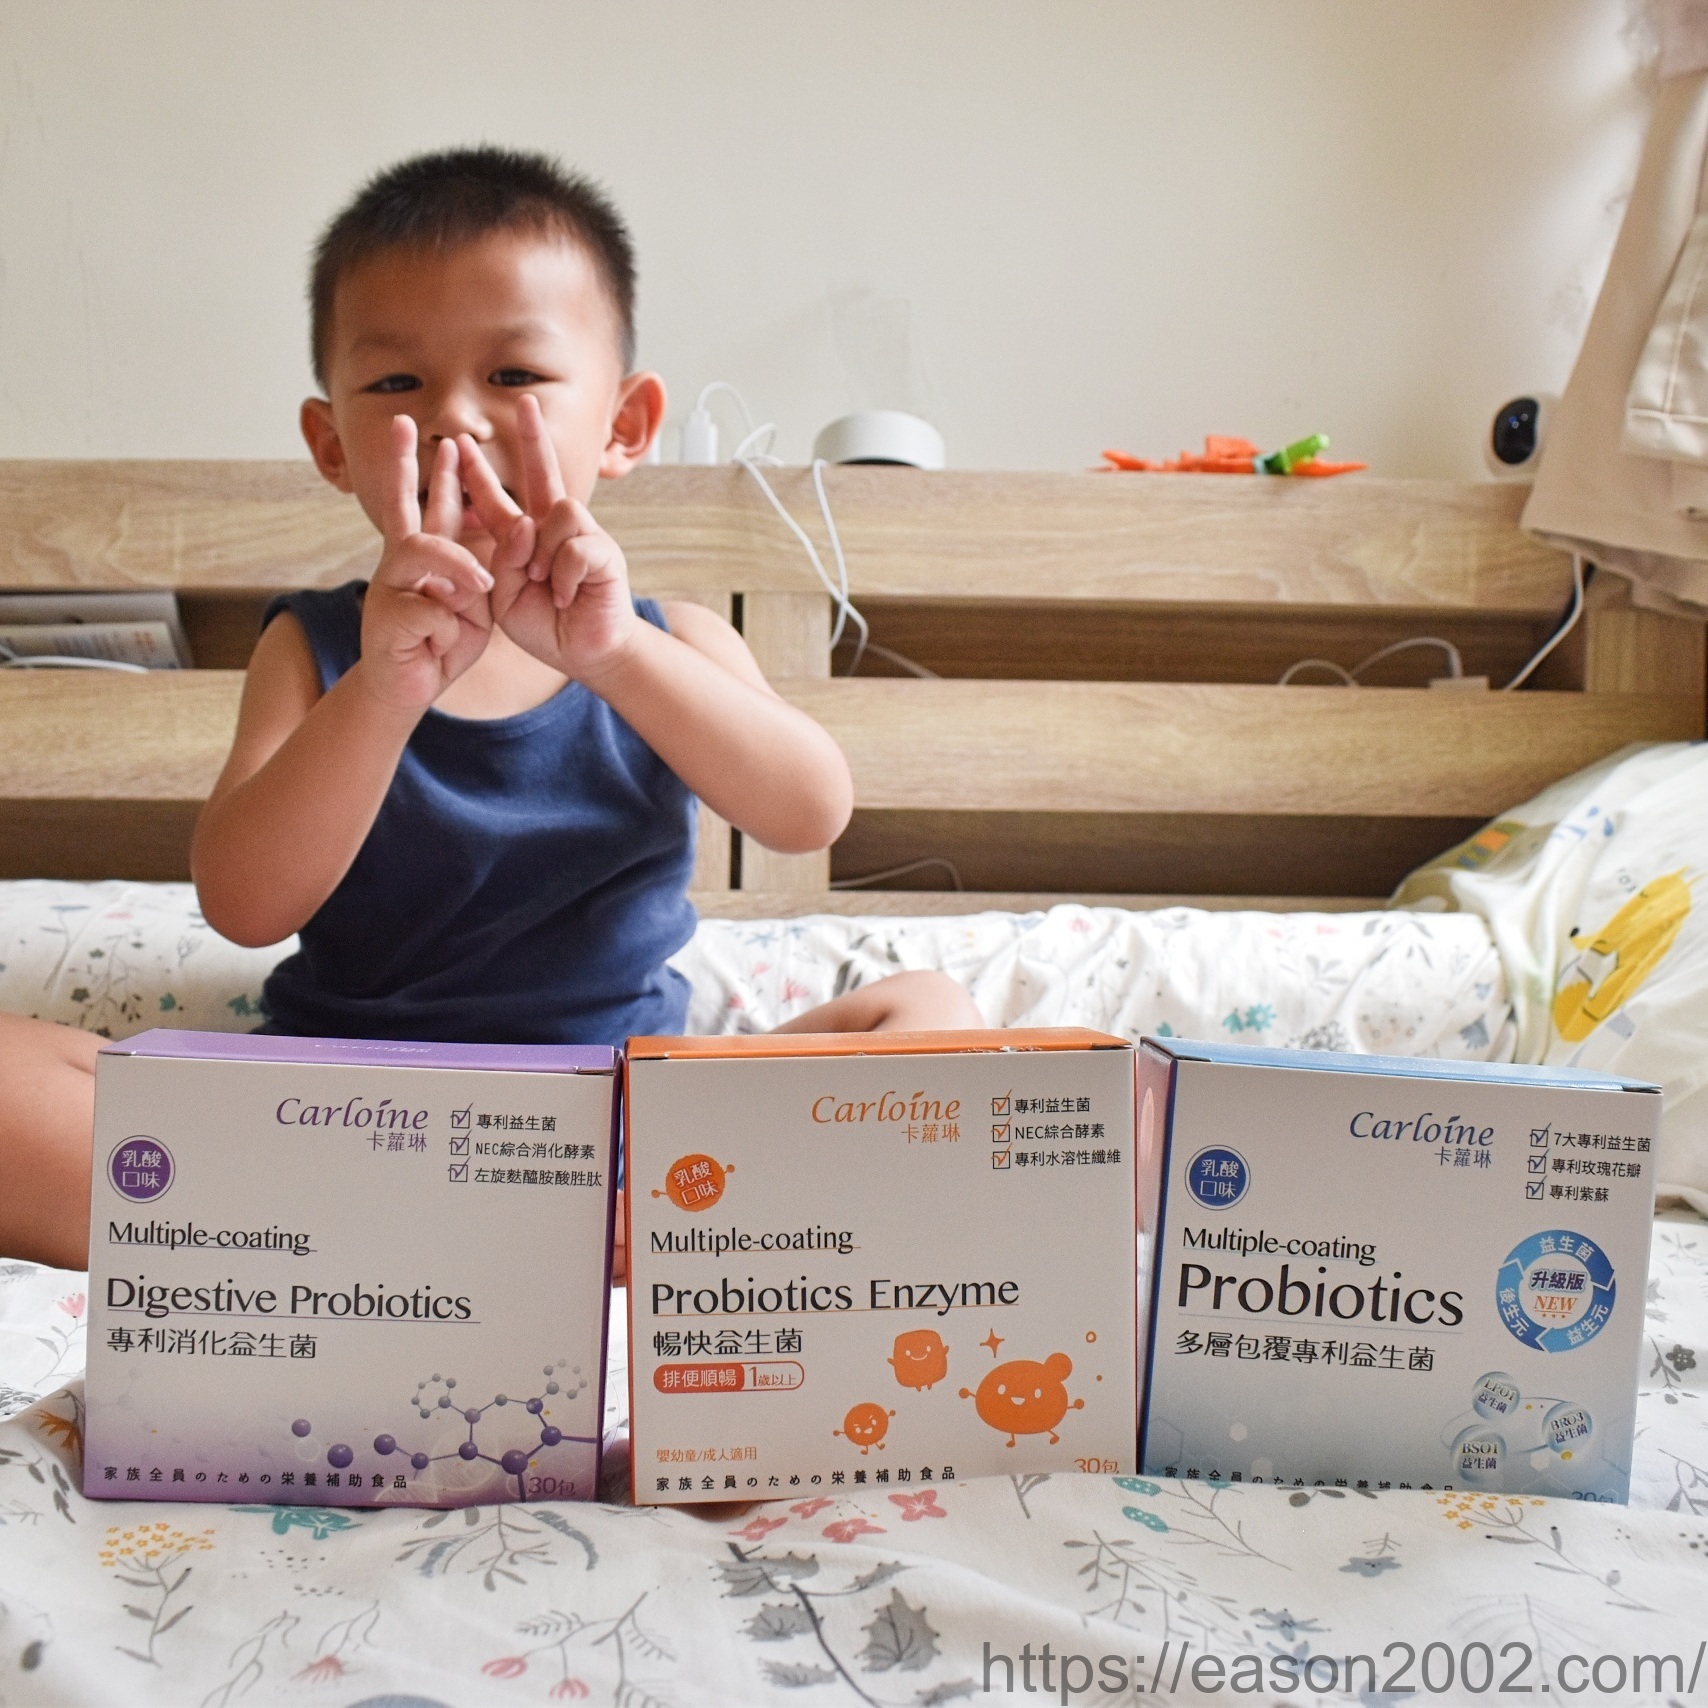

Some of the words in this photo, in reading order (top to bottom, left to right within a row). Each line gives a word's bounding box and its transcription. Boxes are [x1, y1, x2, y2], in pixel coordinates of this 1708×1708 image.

[276, 1097, 429, 1129] Carloine
[811, 1090, 961, 1123] Carloine
[1014, 1097, 1090, 1114] 專利益生菌
[477, 1113, 557, 1132] 專利益生菌
[901, 1123, 960, 1143] 卡蘿琳
[1014, 1122, 1105, 1140] NEC綜合酵素
[1350, 1111, 1494, 1147] Carloine
[366, 1131, 427, 1152] 卡蘿琳
[475, 1142, 595, 1160] NEC綜合消化酵素
[1553, 1132, 1652, 1152] 7大專利益生菌
[121, 1150, 162, 1168] 乳酸
[1014, 1149, 1121, 1167] 專利水溶性纖維
[1434, 1146, 1492, 1169] 卡蘿琳
[674, 1161, 713, 1187] 乳酸
[1200, 1158, 1239, 1179] 乳酸
[1552, 1158, 1641, 1179] 專利玫瑰花瓣
[122, 1171, 160, 1188] 口味
[1199, 1180, 1236, 1199] 口味
[681, 1180, 718, 1205] 口味
[1550, 1184, 1609, 1203] 專利紫蘇
[109, 1221, 310, 1256] Multiple-coating
[651, 1225, 853, 1257] Multiple-coating
[1183, 1227, 1376, 1267] Multiple-coating
[1539, 1235, 1595, 1262] 益生菌
[1530, 1271, 1585, 1290] 升級版
[107, 1275, 277, 1318] Digestive
[291, 1283, 472, 1320] Probiotics
[652, 1276, 853, 1315] Probiotics
[870, 1279, 1019, 1316] Enzyme
[1178, 1263, 1464, 1326] Probiotics
[1533, 1295, 1578, 1311] NEW
[1567, 1304, 1609, 1345] 益生元
[106, 1326, 318, 1359] 專利消化益生菌
[653, 1328, 803, 1356] 暢快益生菌
[1175, 1330, 1436, 1372] 多層包覆專利益生菌
[663, 1369, 737, 1388] 排便順暢
[1477, 1391, 1508, 1414] 益生菌
[1555, 1423, 1588, 1444] 益生菌
[1462, 1457, 1497, 1470] 益生菌
[529, 1477, 576, 1497] 30包
